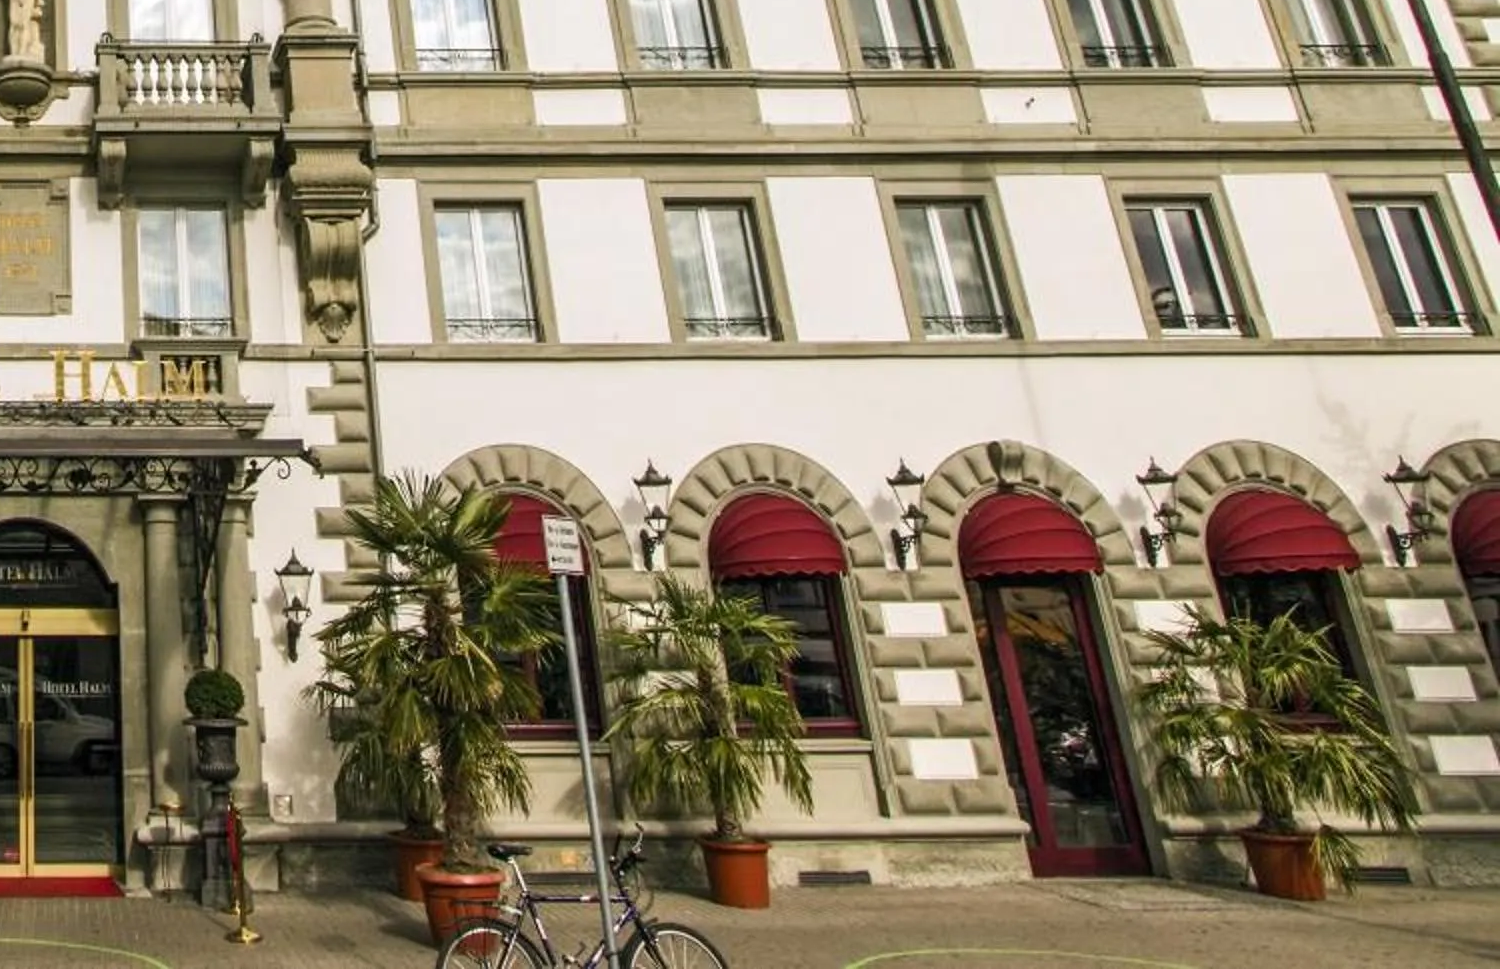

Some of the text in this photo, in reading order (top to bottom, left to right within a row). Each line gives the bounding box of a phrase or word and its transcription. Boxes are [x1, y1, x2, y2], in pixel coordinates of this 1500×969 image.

[48, 349, 207, 402] HALM
[27, 561, 77, 581] HALM
[43, 680, 79, 694] HOTEL
